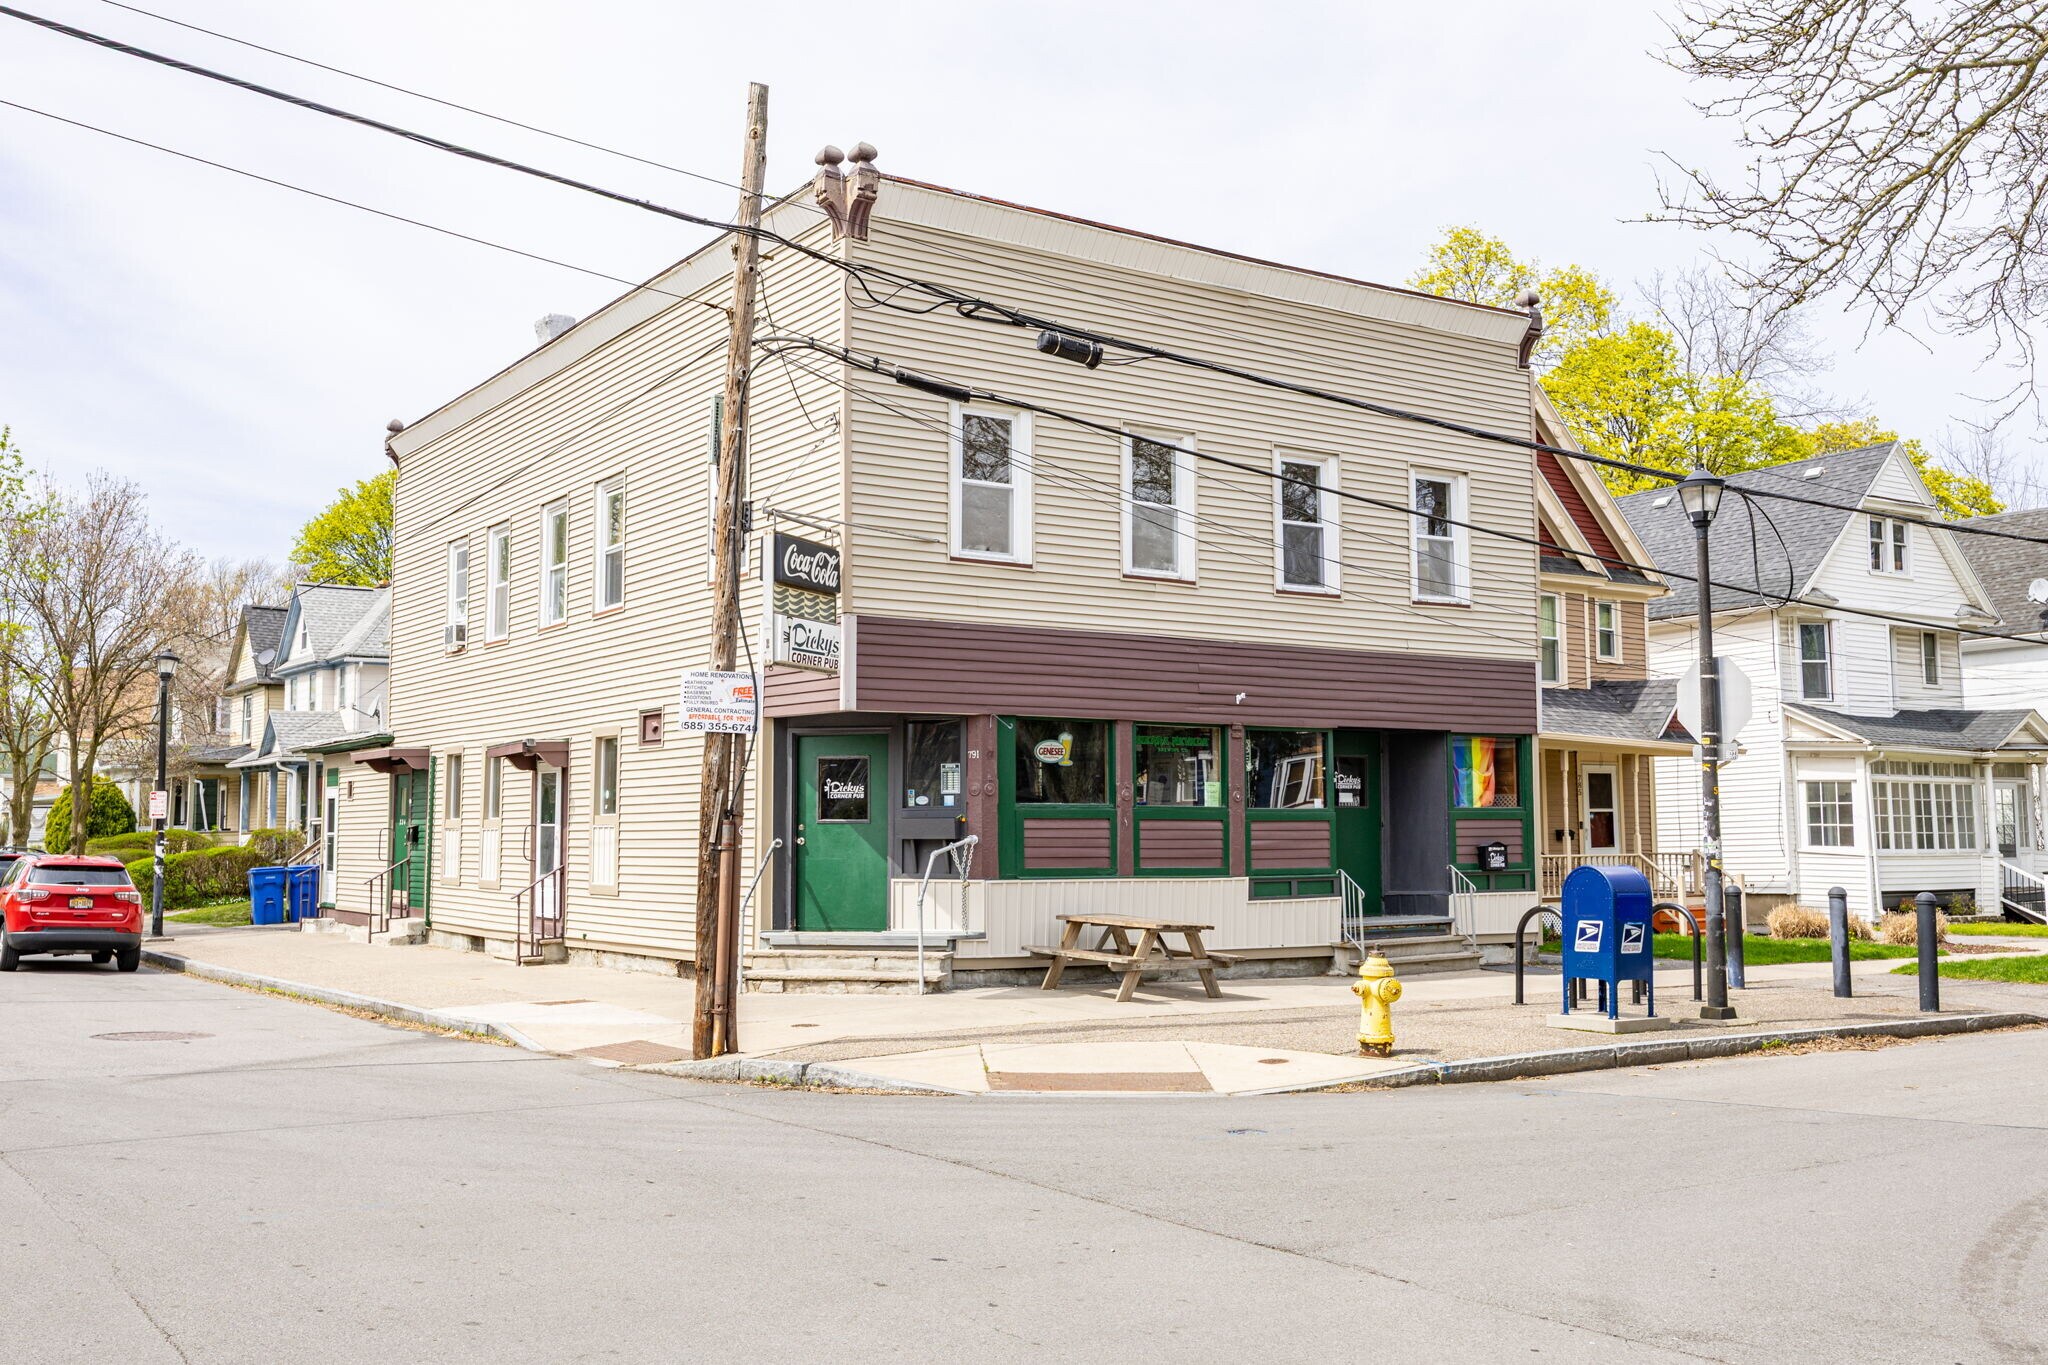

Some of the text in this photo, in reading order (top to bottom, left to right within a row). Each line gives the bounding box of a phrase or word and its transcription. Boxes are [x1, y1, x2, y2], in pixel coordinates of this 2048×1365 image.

[784, 544, 839, 587] Coca-Cola
[792, 623, 839, 657] Dicky's
[792, 652, 823, 667] CORNER
[824, 657, 839, 670] PUB
[733, 686, 753, 696] FREE
[688, 713, 721, 721] AFFORDABLE
[681, 721, 706, 730] (585)
[968, 750, 979, 758] 791
[1039, 747, 1064, 755] GENESEE
[830, 781, 865, 794] Dicky's
